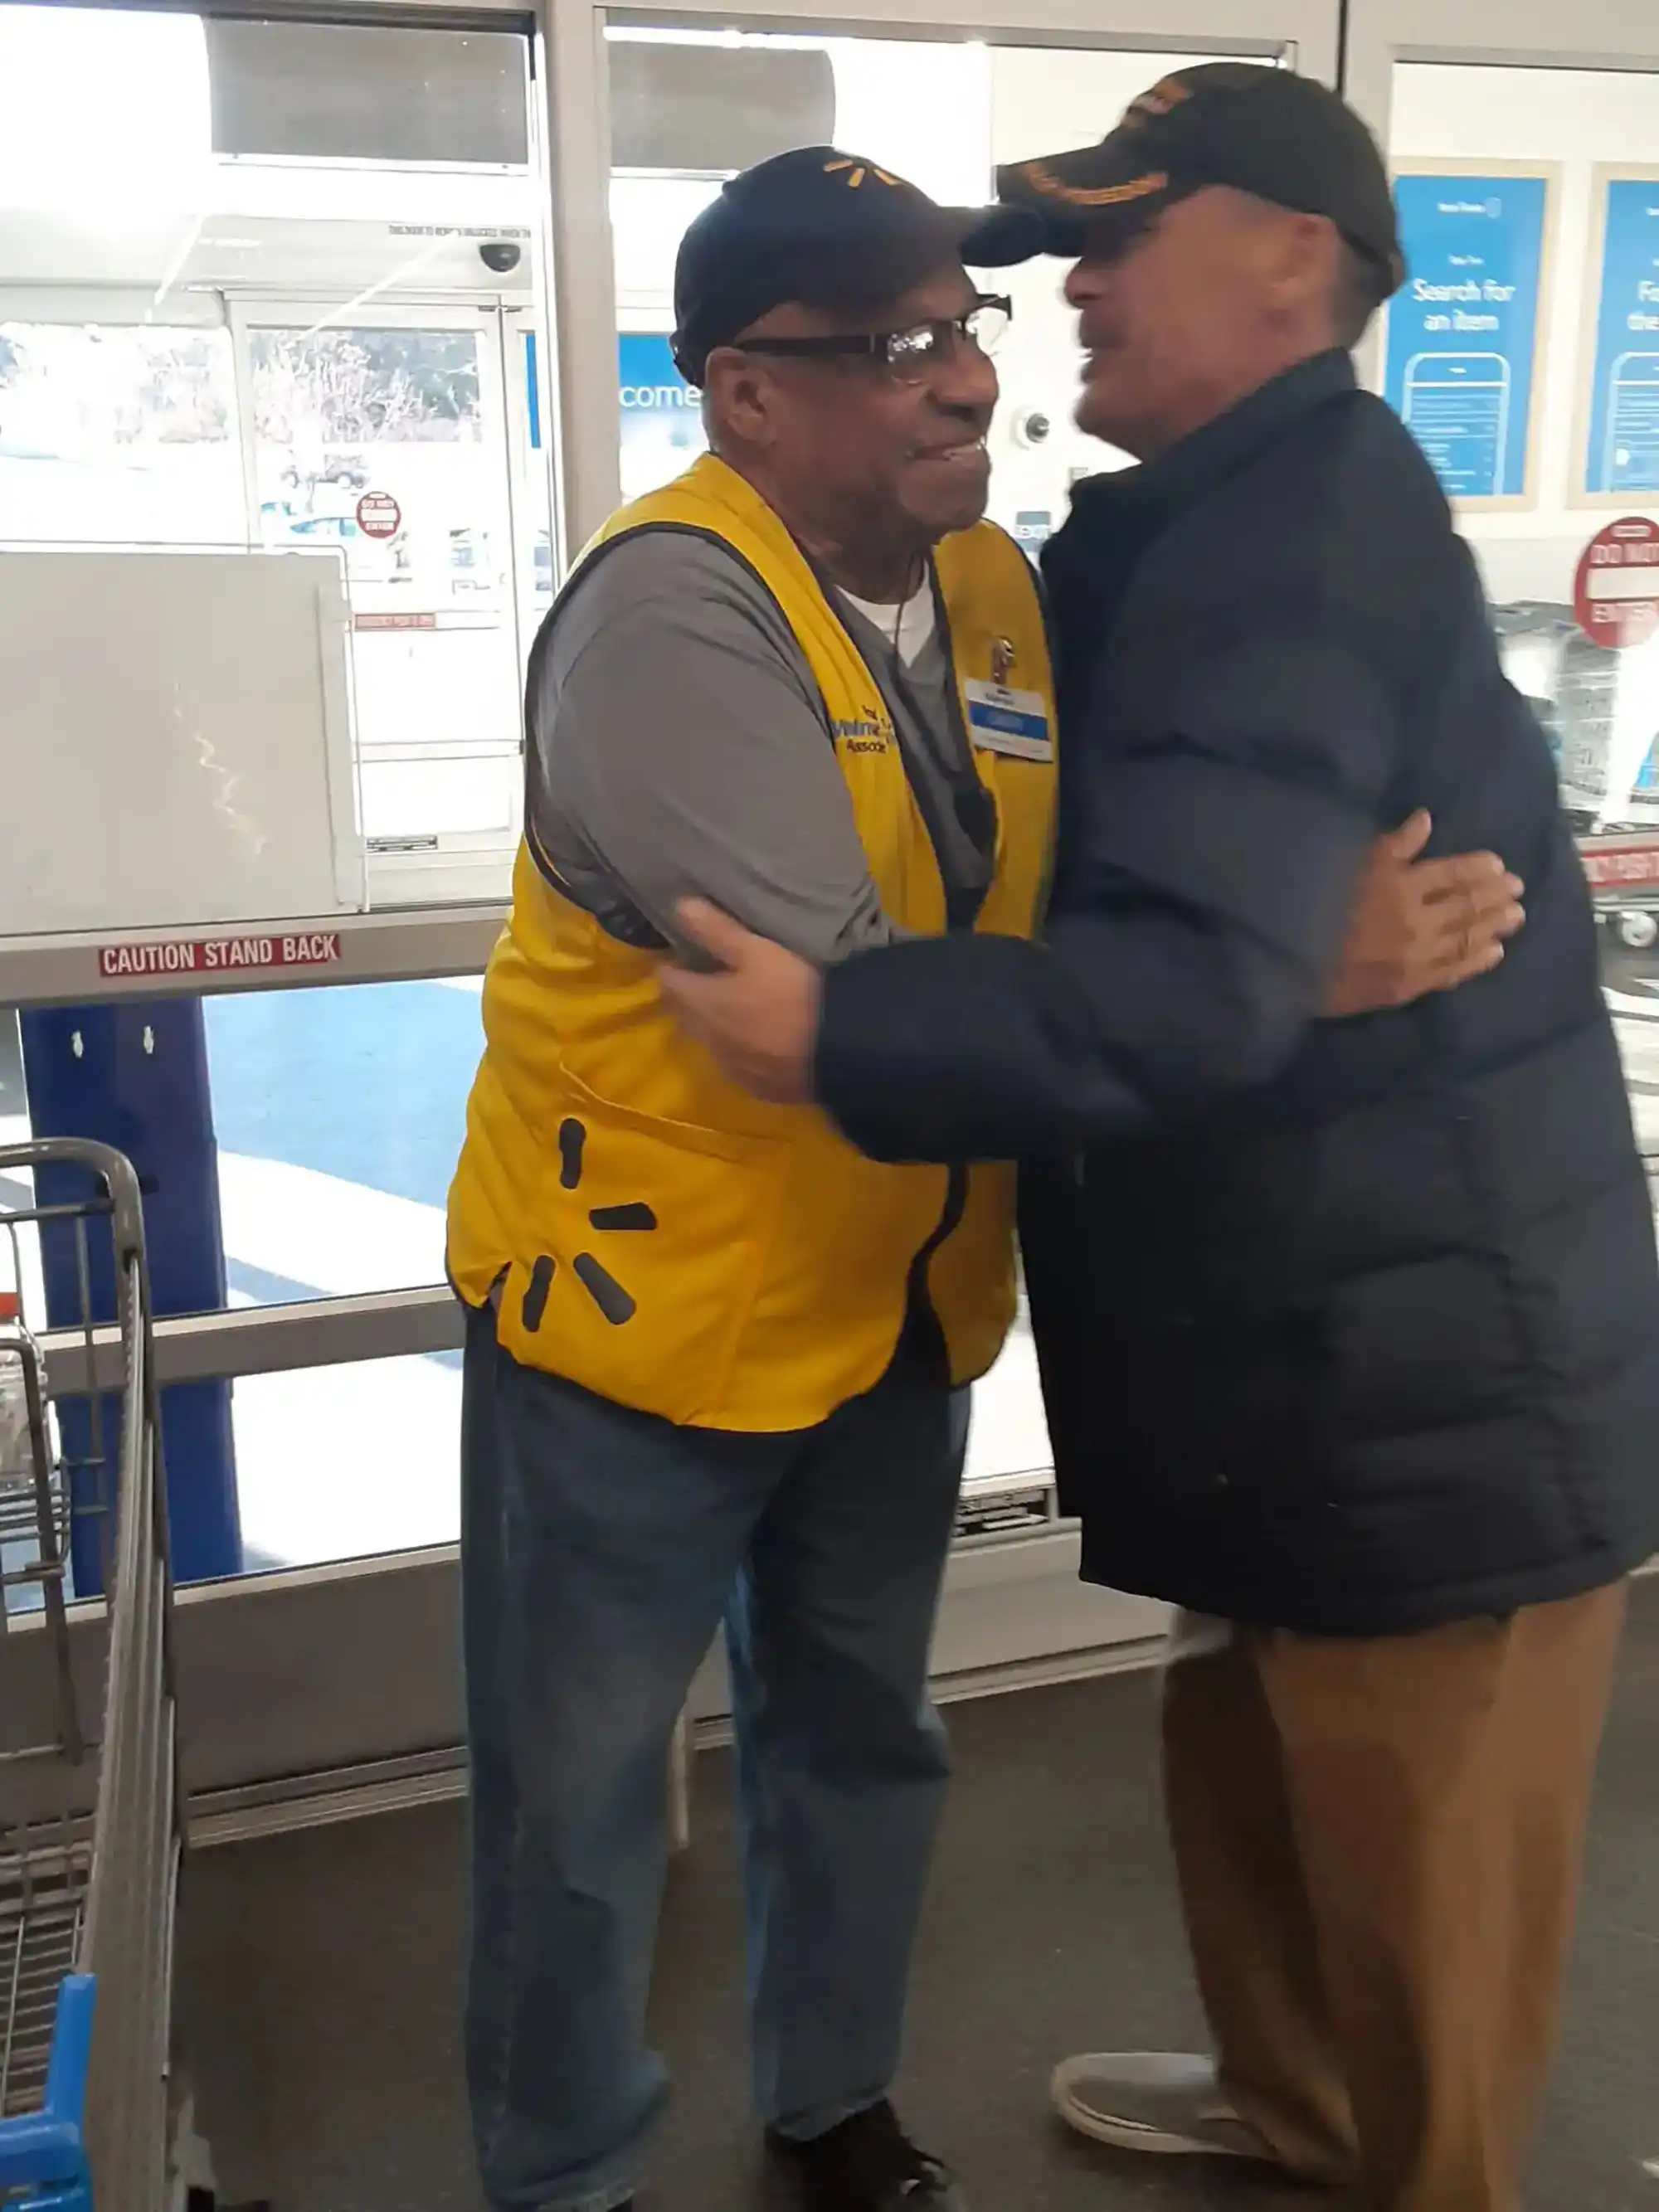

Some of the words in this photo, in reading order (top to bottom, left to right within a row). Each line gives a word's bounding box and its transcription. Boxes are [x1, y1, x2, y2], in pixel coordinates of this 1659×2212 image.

[619, 386, 703, 407] come
[104, 944, 195, 975] CAUTION
[205, 938, 273, 967] STAND
[283, 934, 339, 962] BACK
